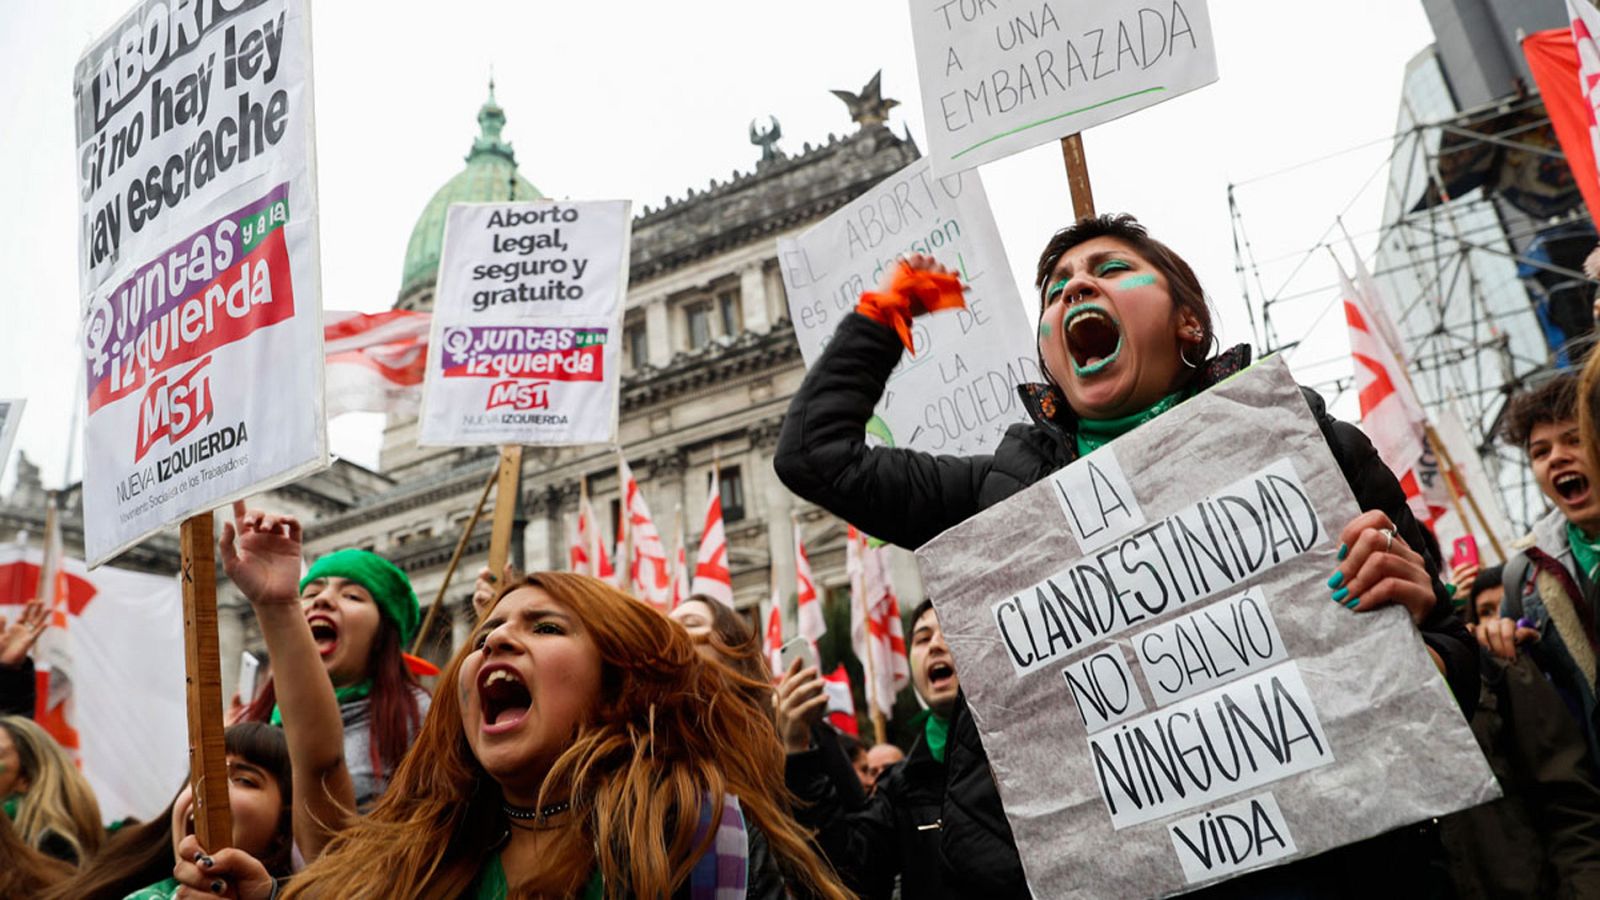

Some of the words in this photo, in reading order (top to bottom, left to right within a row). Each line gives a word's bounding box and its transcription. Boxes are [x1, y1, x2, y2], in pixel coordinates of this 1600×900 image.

[940, 0, 1197, 132] EMBARAZADA
[946, 46, 963, 77] A
[996, 2, 1060, 51] UNA
[81, 130, 106, 203] Si
[108, 111, 144, 177] no
[151, 52, 216, 140] hay
[224, 10, 286, 90] ley
[127, 89, 289, 233] escrache
[487, 206, 579, 229] Aborto
[493, 228, 568, 255] legal,
[783, 248, 828, 290] EL
[846, 166, 963, 259] ABORTO
[116, 219, 238, 340] juntas
[242, 223, 253, 245] y
[256, 219, 266, 235] a
[269, 202, 286, 225] la
[472, 258, 567, 283] seguro
[572, 258, 588, 280] y
[472, 280, 584, 312] gratuito
[800, 301, 828, 329] es
[832, 273, 865, 311] una
[110, 258, 272, 394] izquierda
[473, 328, 576, 351] juntas
[956, 298, 991, 335] DE
[466, 351, 594, 378] izquierda
[489, 382, 549, 408] MST
[938, 353, 969, 385] LA
[141, 373, 212, 450] MST
[501, 413, 568, 426] IZQUIERDA
[924, 356, 1044, 450] SOCIEDAD
[116, 465, 156, 506] NUEVA
[157, 421, 248, 483] IZQUIERDA
[1056, 460, 1131, 539] LA
[997, 474, 1319, 667] CLANDESTINIDAD
[1064, 653, 1130, 726] NO
[1142, 589, 1273, 693] SALVÓ
[1091, 675, 1324, 815] NINGUNA
[1172, 799, 1286, 870] VIDA
